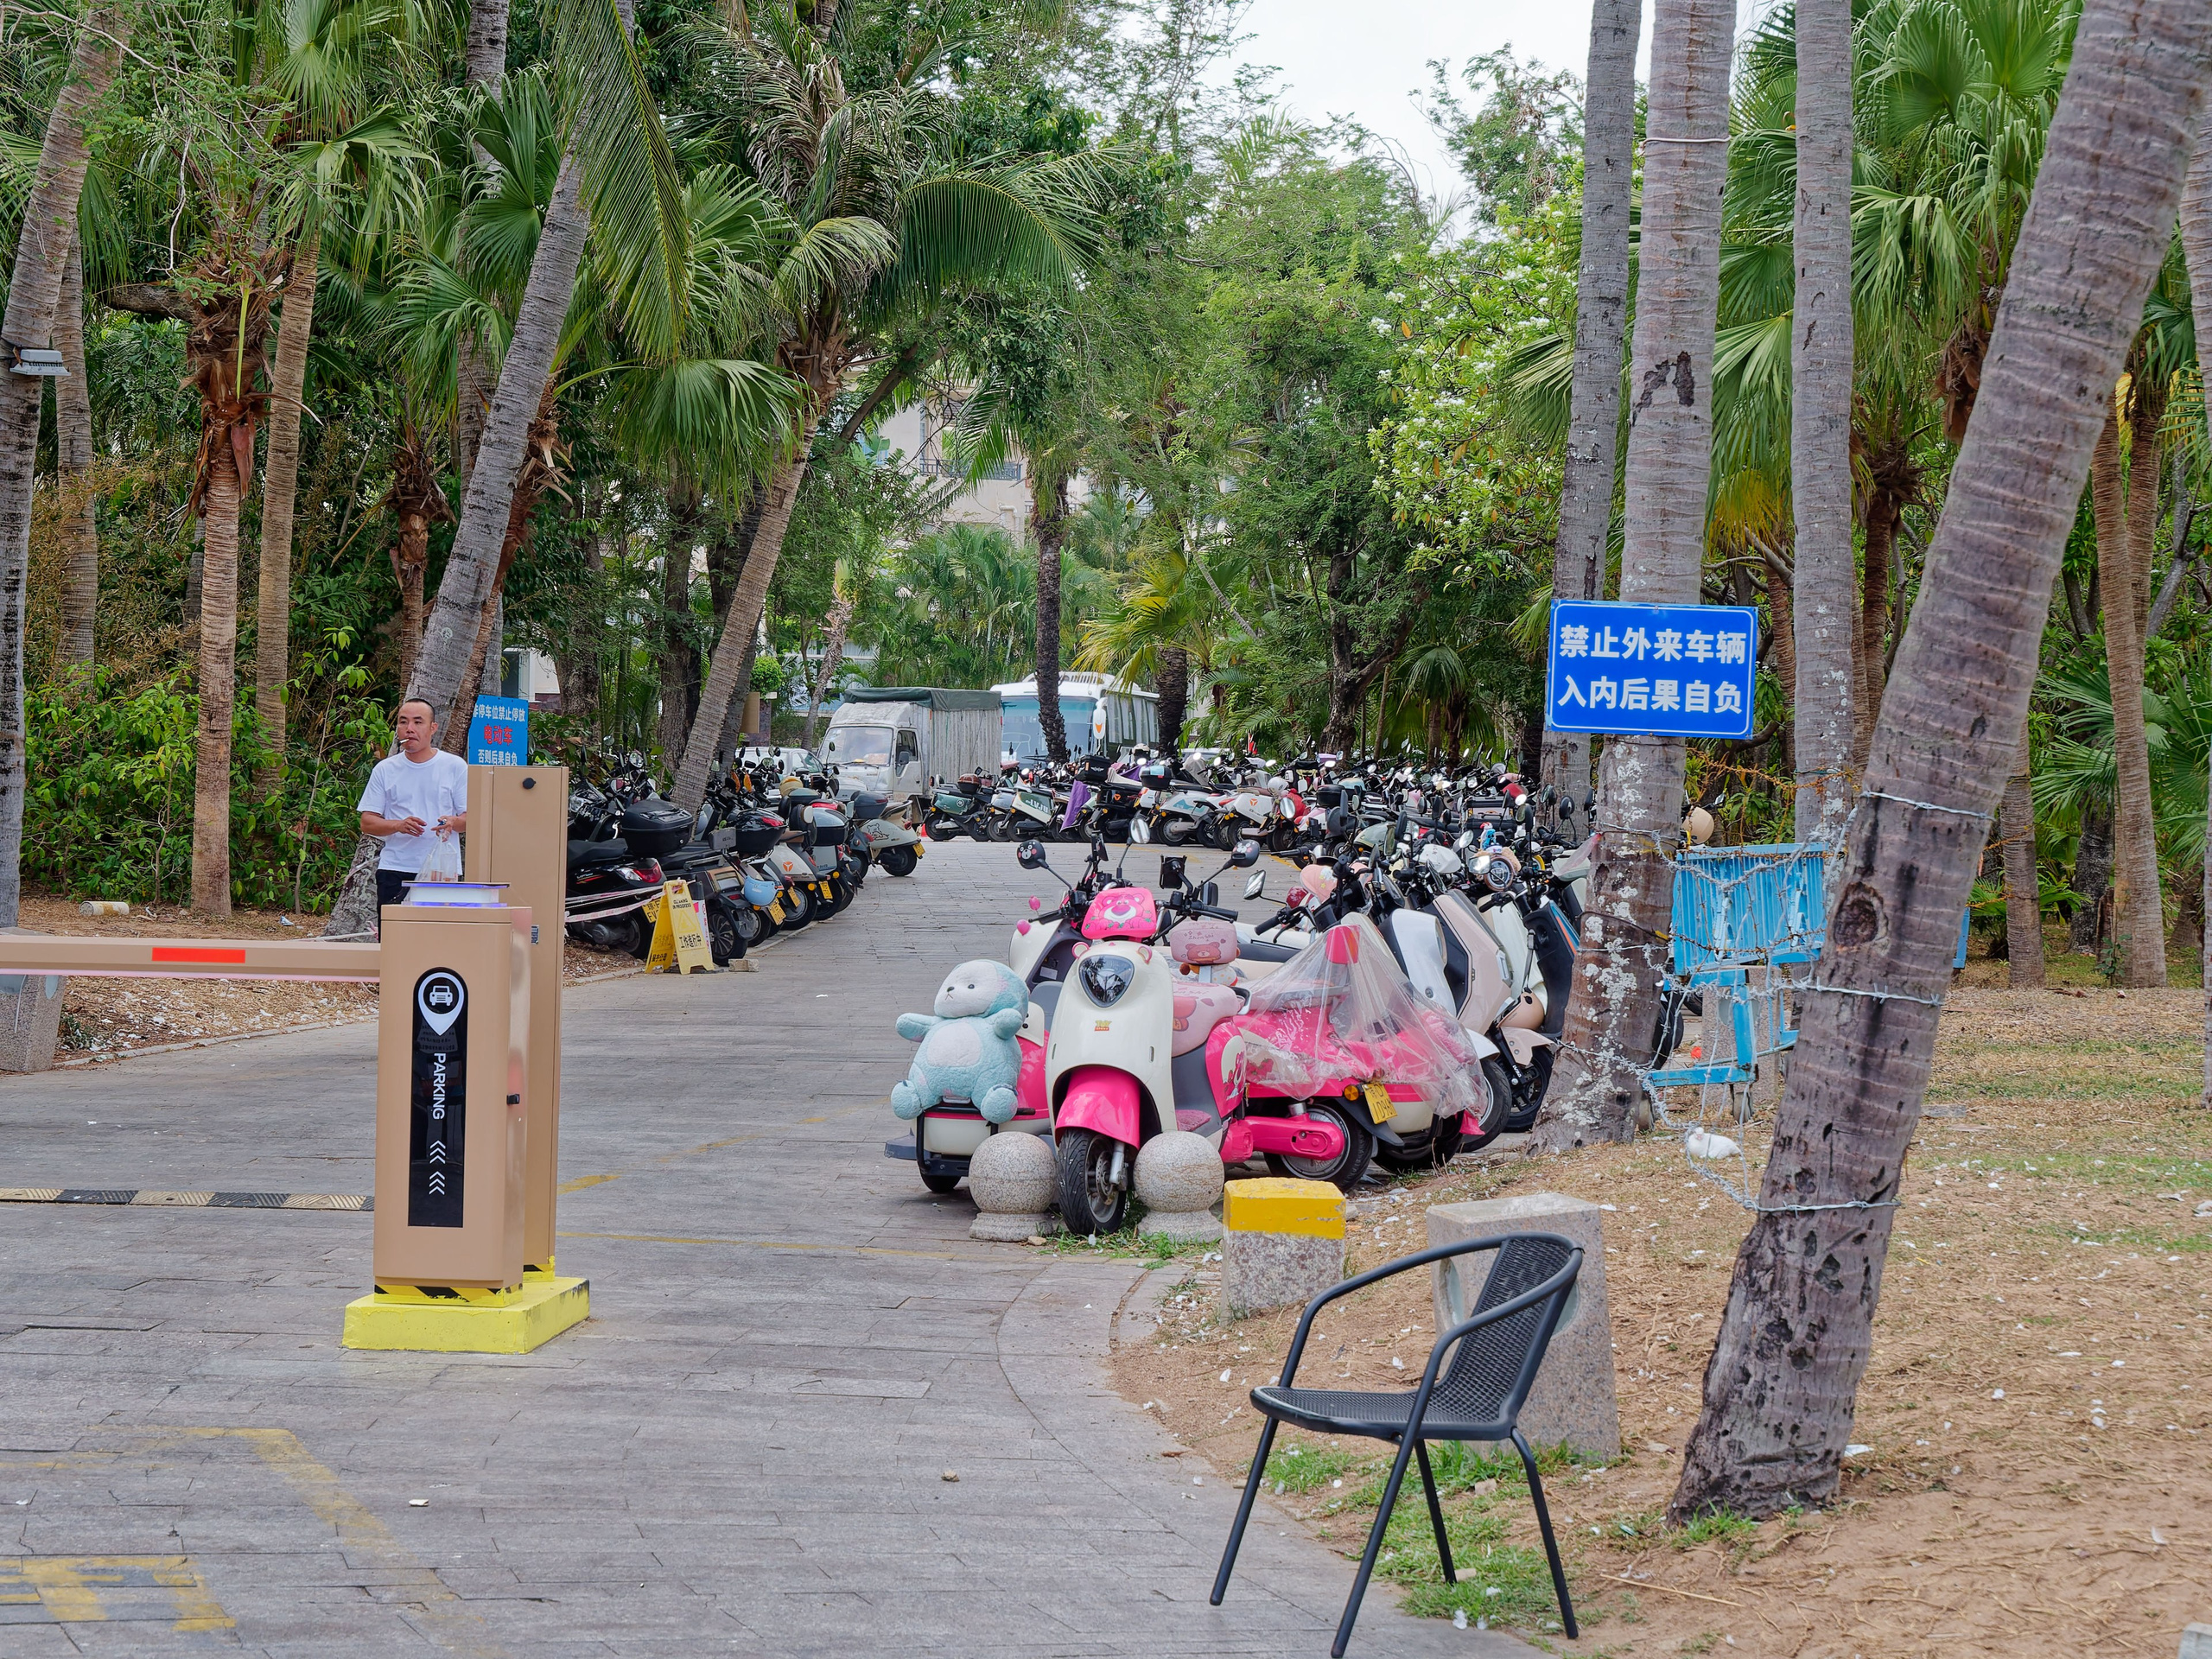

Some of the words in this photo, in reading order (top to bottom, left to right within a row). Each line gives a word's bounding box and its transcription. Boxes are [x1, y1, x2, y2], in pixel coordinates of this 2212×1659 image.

[1559, 623, 1747, 664] 禁止外来车辆
[1557, 674, 1743, 715] 入内后果自负
[484, 724, 513, 746] 电动车
[478, 749, 518, 766] 否则后果自负
[432, 1052, 447, 1120] PARKING
